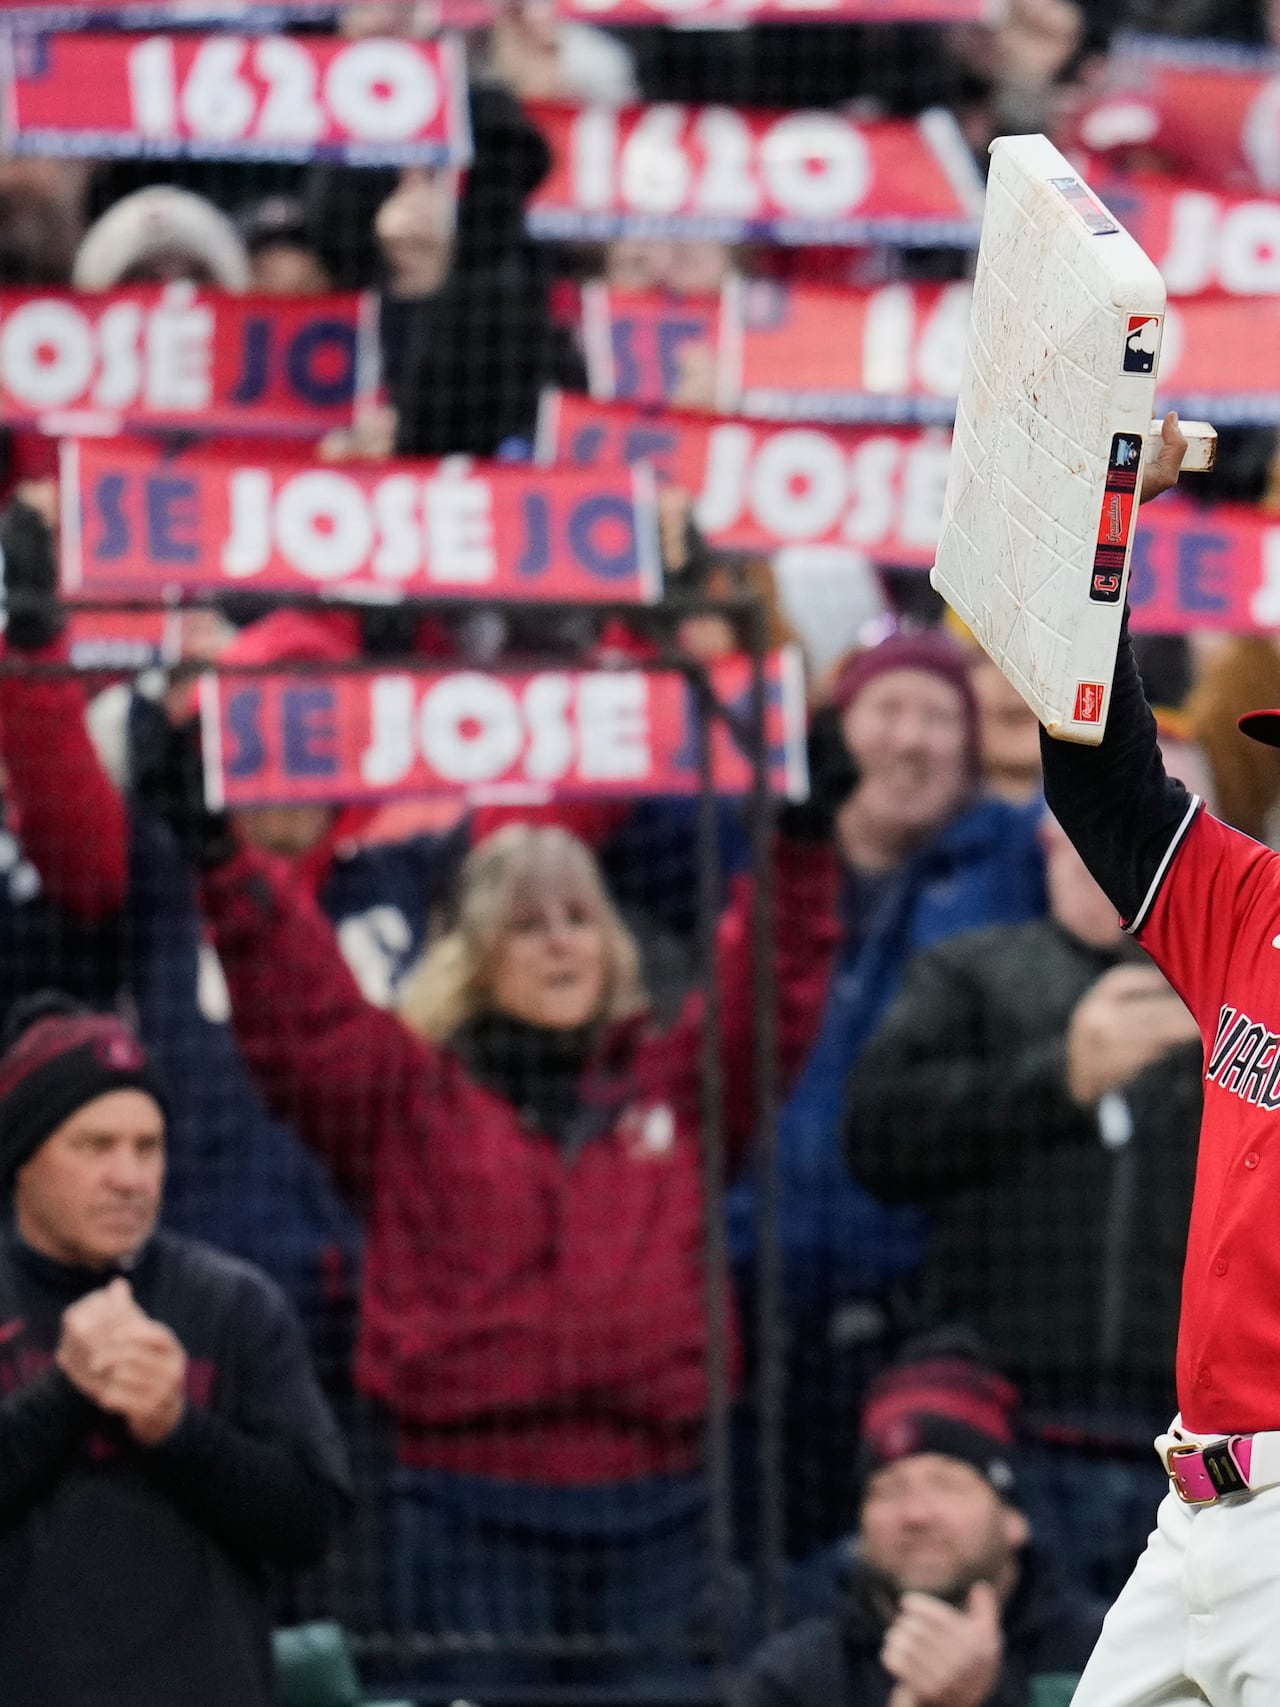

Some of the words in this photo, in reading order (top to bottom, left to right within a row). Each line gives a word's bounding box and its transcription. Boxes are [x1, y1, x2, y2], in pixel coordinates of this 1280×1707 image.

[130, 35, 441, 141] 1620
[572, 104, 870, 221] 1620
[233, 317, 357, 410] JO
[516, 491, 642, 580] JO
